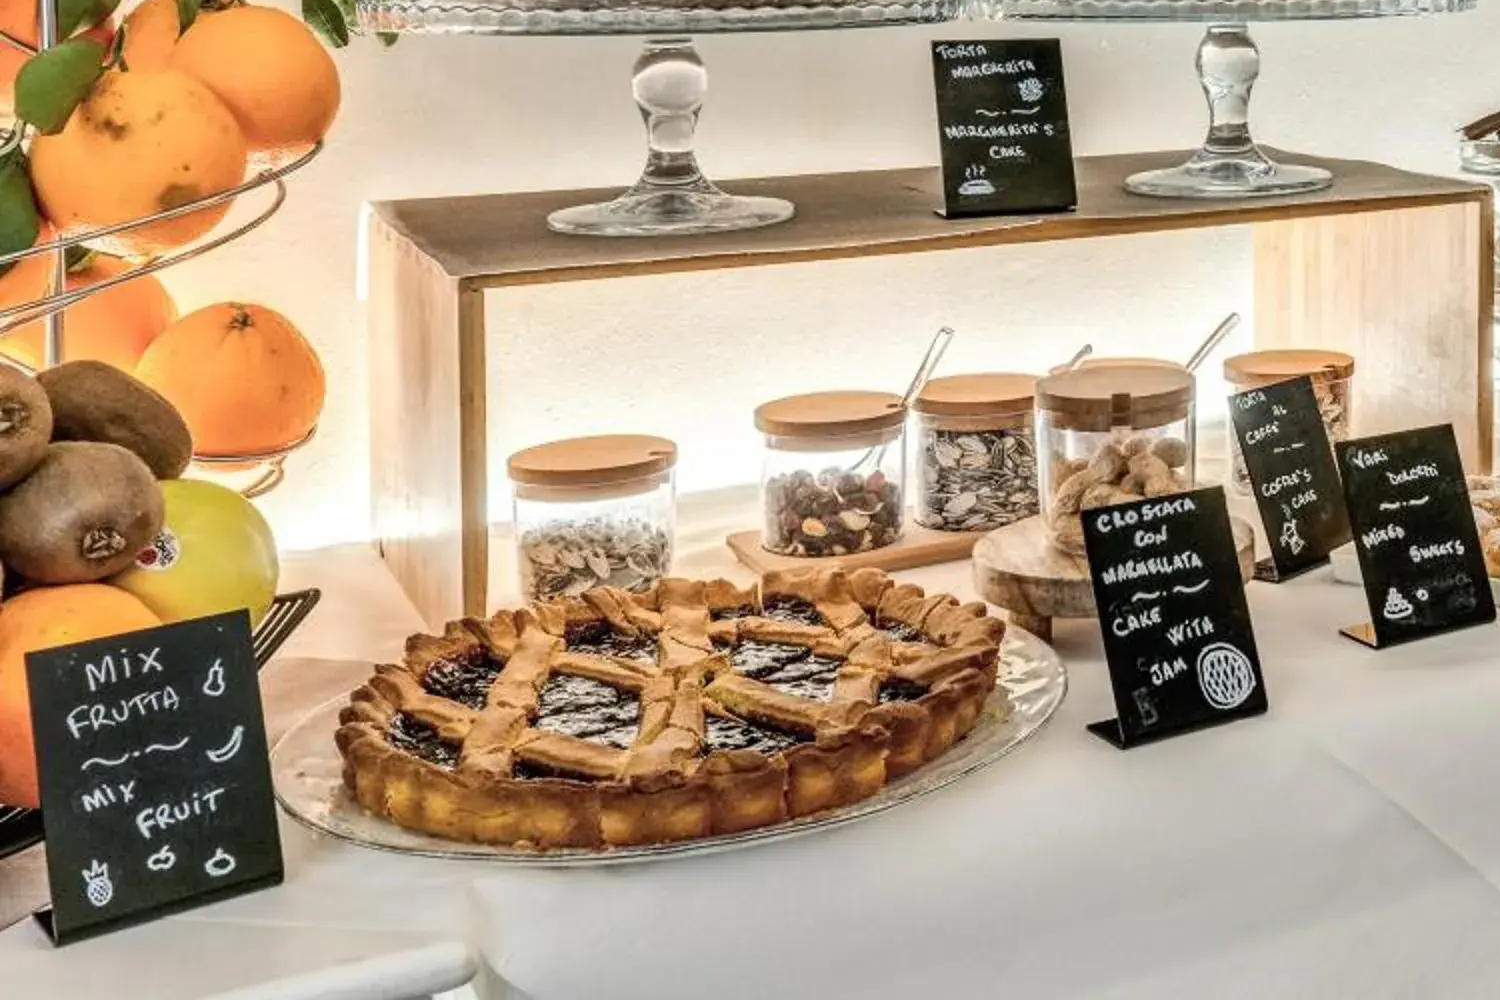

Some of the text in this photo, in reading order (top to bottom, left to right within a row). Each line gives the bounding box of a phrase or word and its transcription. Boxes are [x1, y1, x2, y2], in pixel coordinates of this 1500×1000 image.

[1096, 498, 1196, 533] CROSTATA
[1133, 524, 1168, 547] CON
[1101, 551, 1203, 585] MARMELLATA
[1112, 606, 1162, 637] CAKE
[1150, 657, 1188, 686] JAM
[66, 685, 180, 739] FRUTTA
